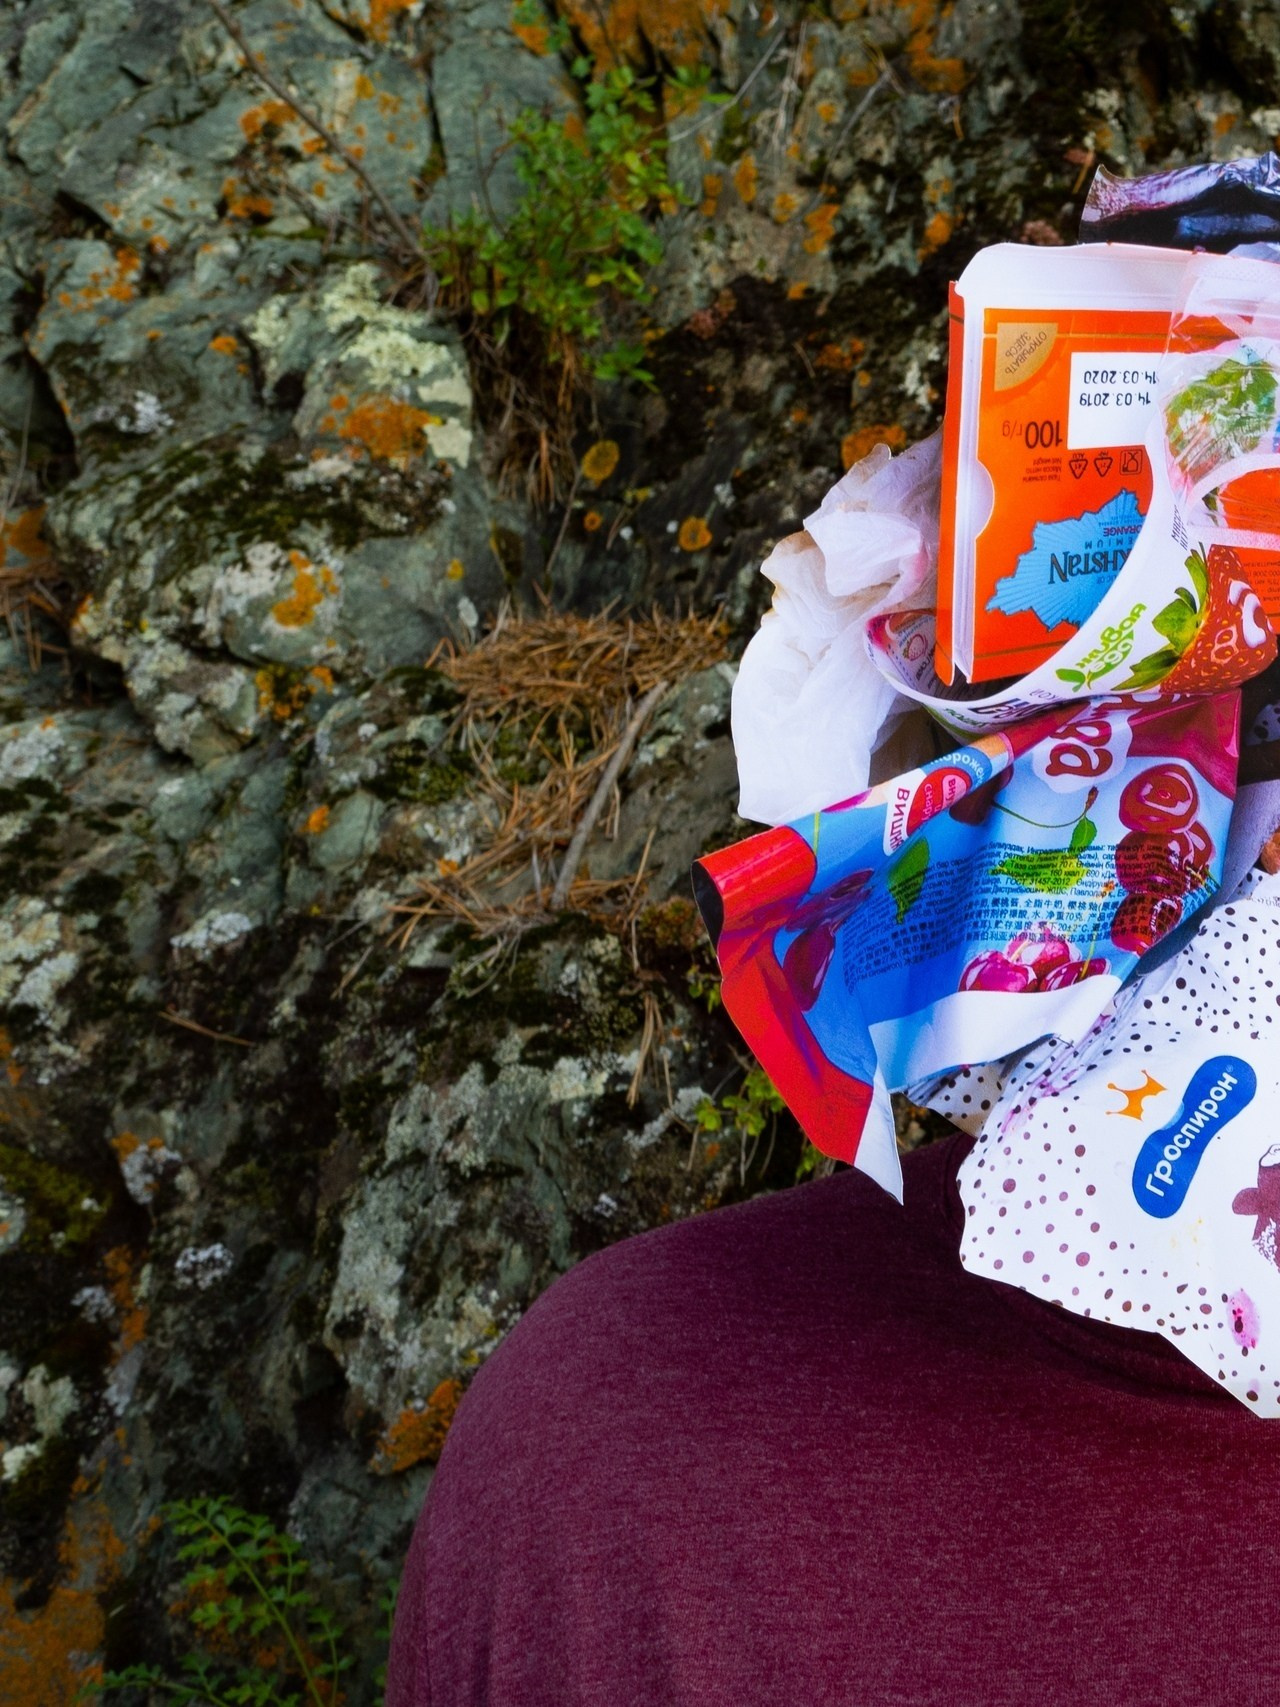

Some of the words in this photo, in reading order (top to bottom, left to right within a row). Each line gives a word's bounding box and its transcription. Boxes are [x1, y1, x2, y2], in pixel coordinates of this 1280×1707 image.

[1004, 332, 1031, 359] ЗДЕСЬ
[1004, 329, 1048, 375] ОТКРЫВАТЬ
[1083, 369, 1157, 384] 14.03.2020
[1078, 391, 1151, 406] 14.03.2019
[1024, 420, 1063, 449] 100
[1102, 525, 1143, 537] ORANGE
[1083, 539, 1132, 549] EMIUM
[1144, 1071, 1239, 1198] Гроспирон
